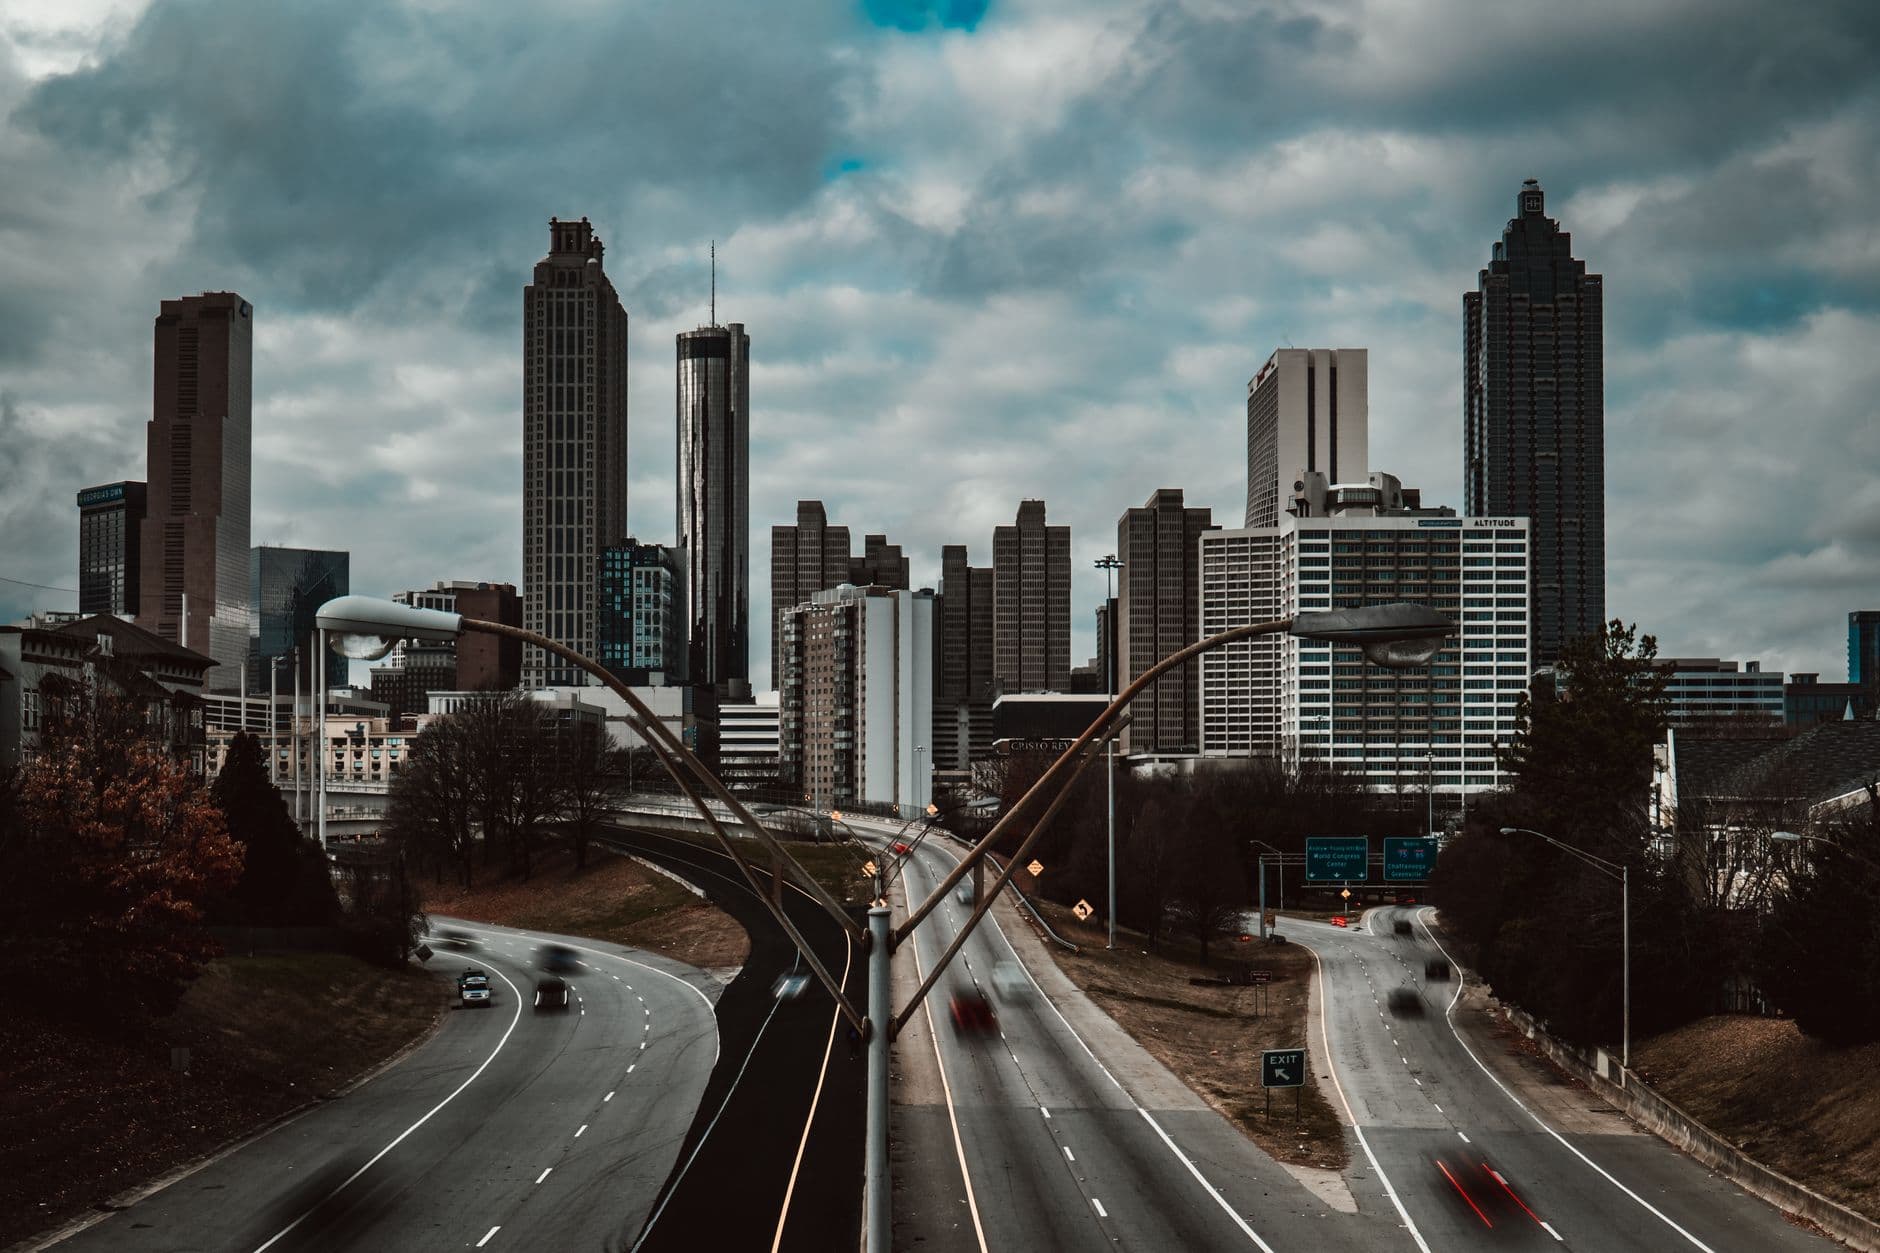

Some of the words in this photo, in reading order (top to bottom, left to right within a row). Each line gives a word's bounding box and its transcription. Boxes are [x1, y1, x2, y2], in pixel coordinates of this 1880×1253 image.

[1473, 519, 1516, 527] ALTITUDE
[1010, 741, 1048, 751] CRISTO
[1052, 741, 1071, 751] REY
[1332, 853, 1360, 861] Congress
[1399, 851, 1409, 859] 75
[1270, 1054, 1297, 1065] EXIT
